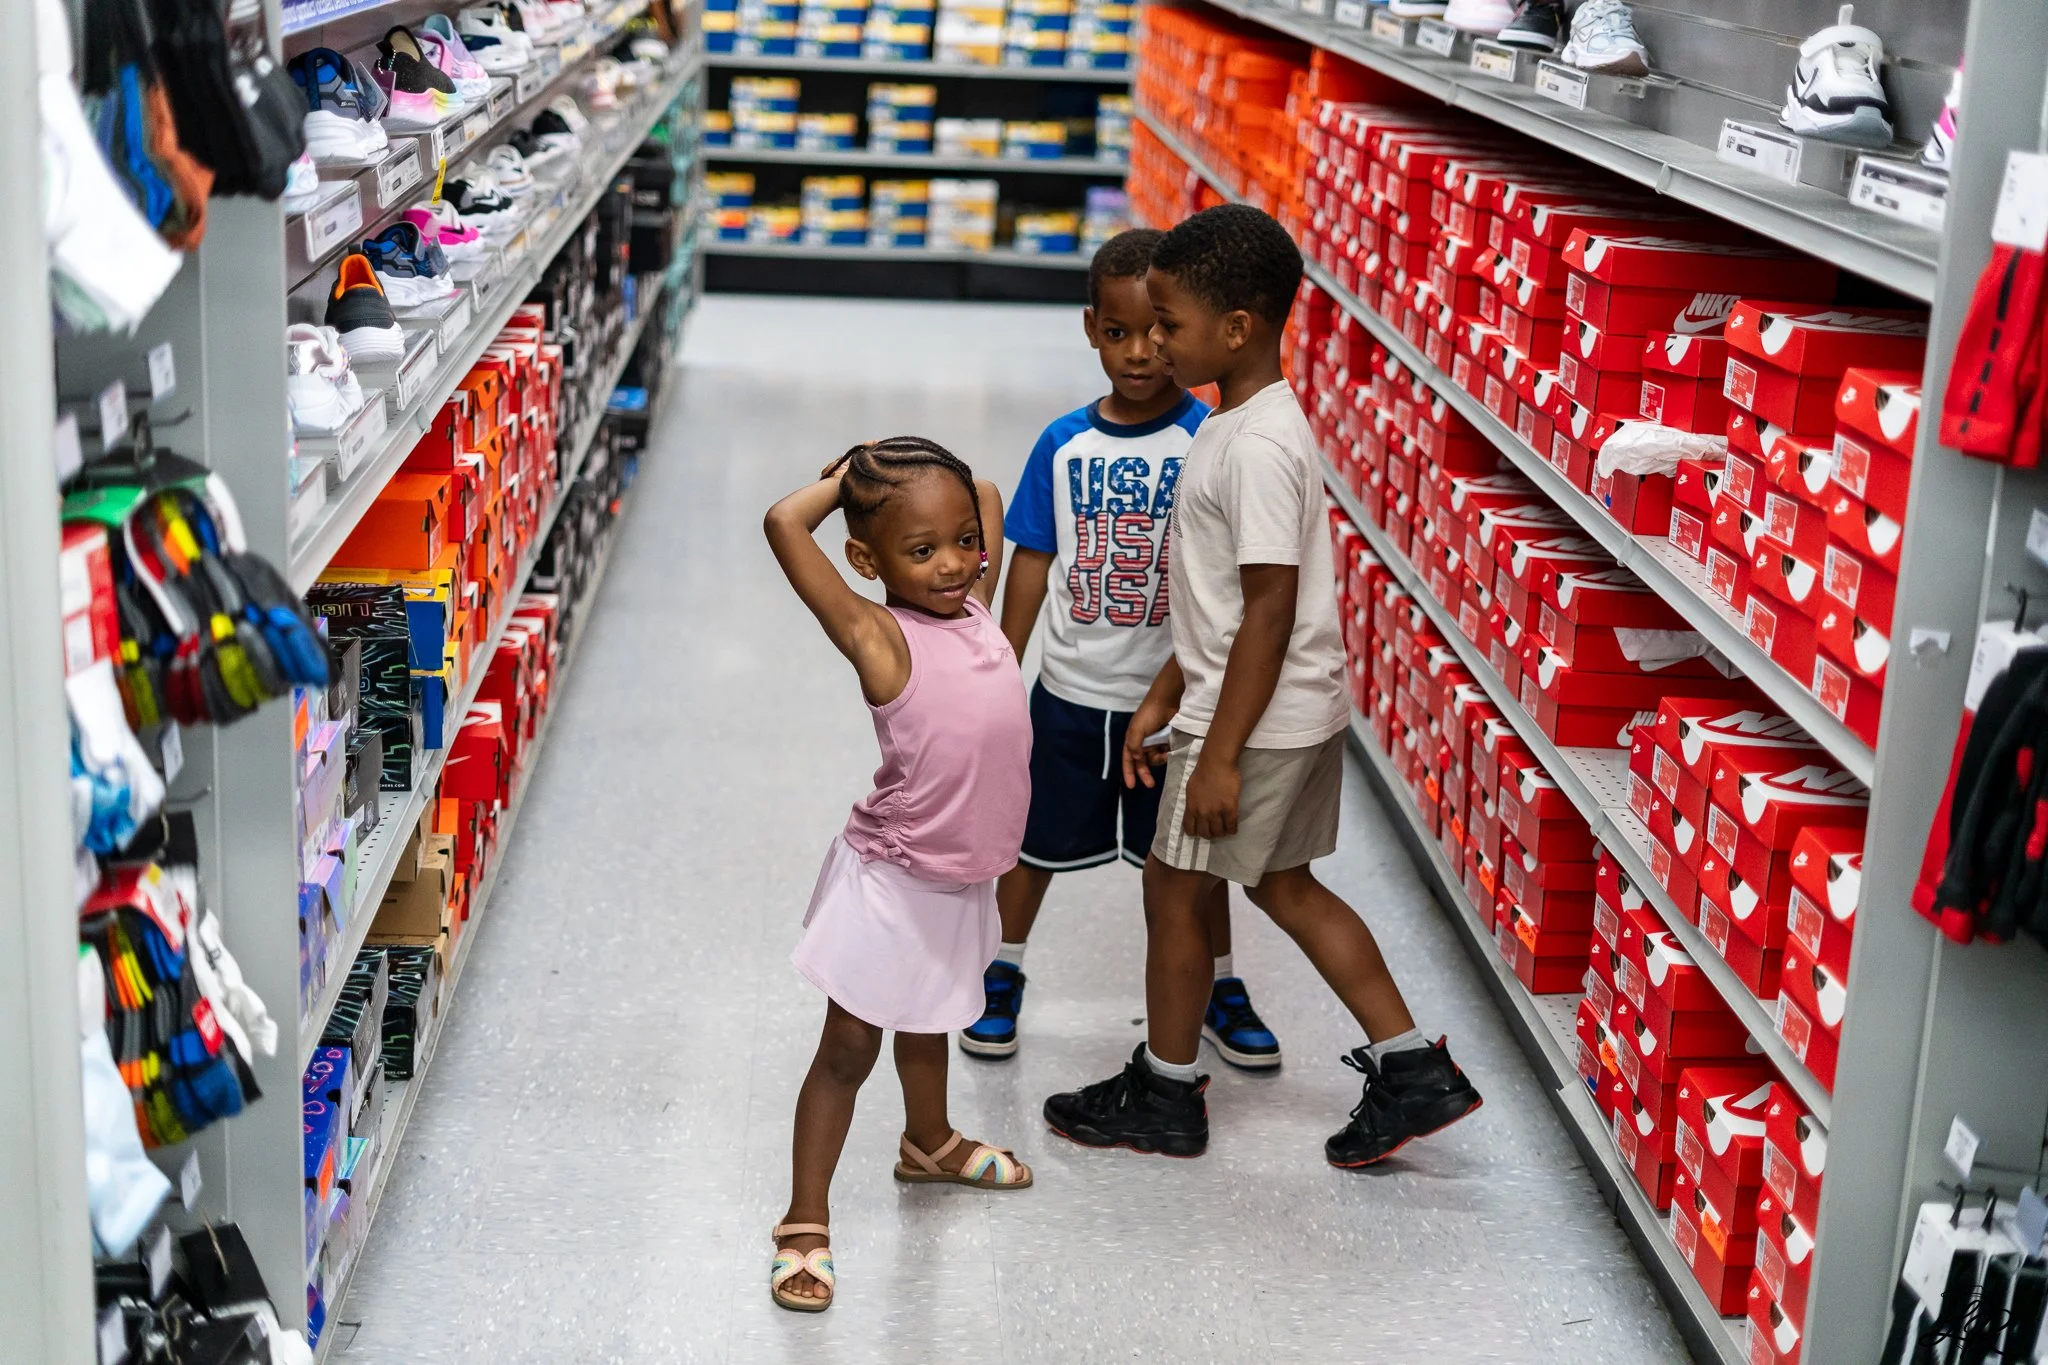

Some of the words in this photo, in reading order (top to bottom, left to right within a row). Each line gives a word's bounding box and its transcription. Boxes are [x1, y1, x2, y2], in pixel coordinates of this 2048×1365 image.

[1686, 292, 1741, 317] NIKE
[1068, 457, 1187, 519] USA
[1768, 765, 1870, 797] NI
